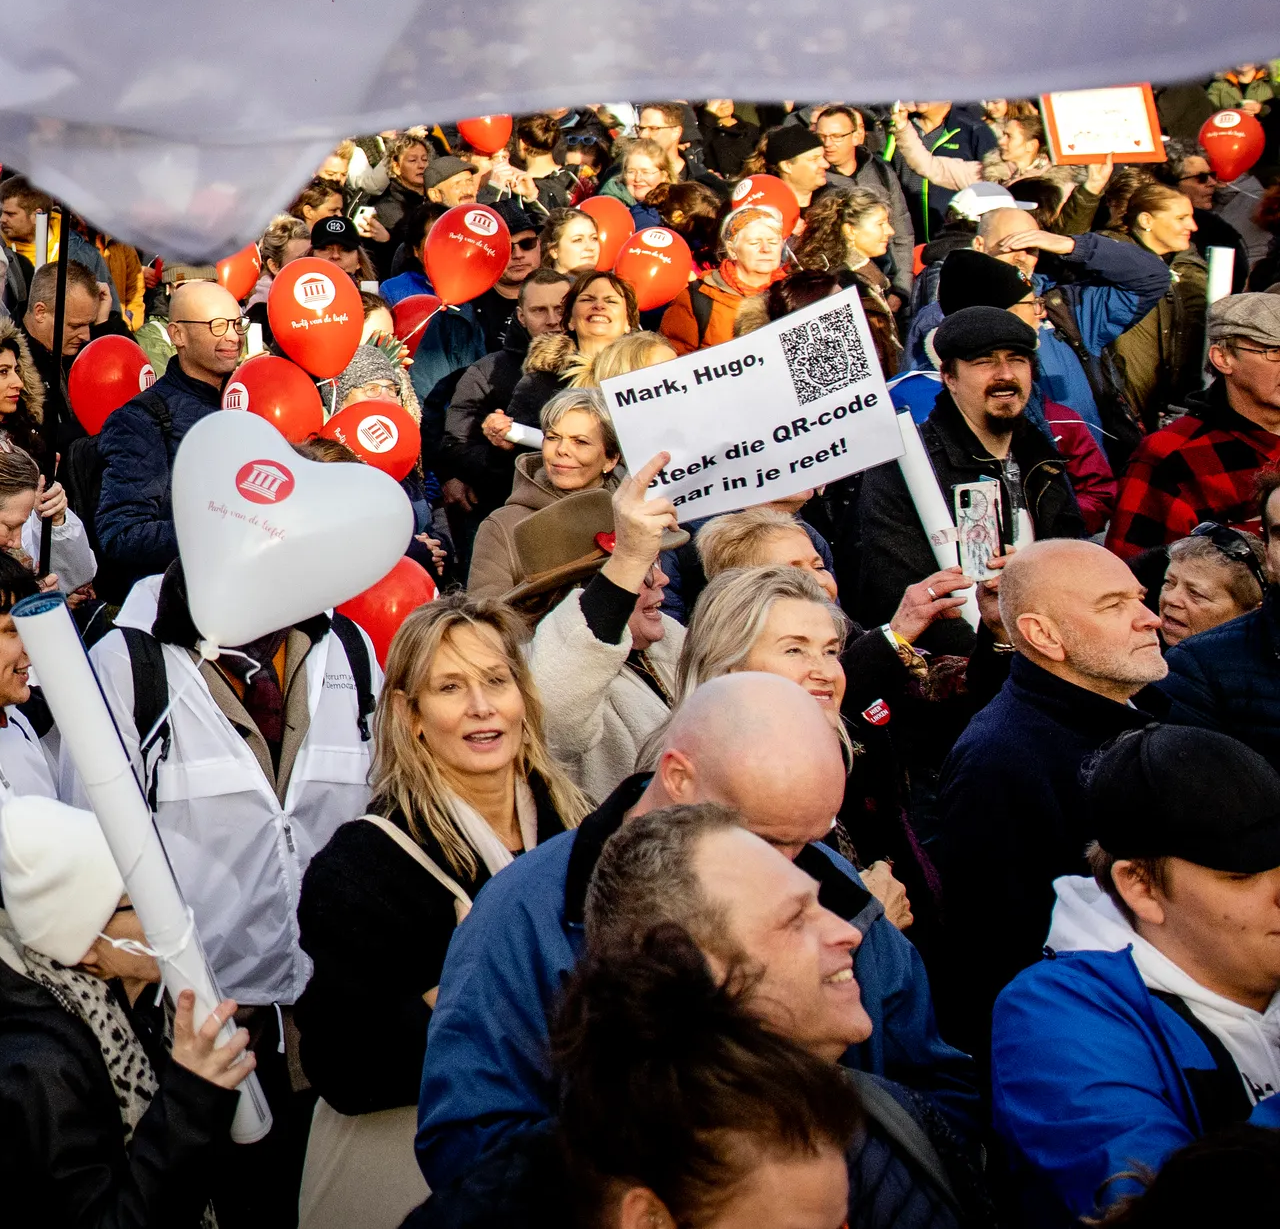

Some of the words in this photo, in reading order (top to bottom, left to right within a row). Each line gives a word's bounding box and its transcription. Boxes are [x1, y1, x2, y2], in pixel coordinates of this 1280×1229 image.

[291, 318, 309, 330] Partij
[323, 313, 332, 323] de
[332, 312, 349, 325] liefde
[615, 377, 688, 408] Mark,
[692, 352, 765, 386] Hugo,
[725, 438, 766, 463] die
[772, 391, 879, 446] QR-code
[673, 484, 715, 508] aar
[723, 475, 748, 493] in
[755, 467, 781, 489] je
[789, 438, 849, 474] reet!
[207, 500, 229, 519] Partij
[229, 510, 247, 521] van
[247, 515, 259, 526] de
[261, 519, 286, 541] liefde
